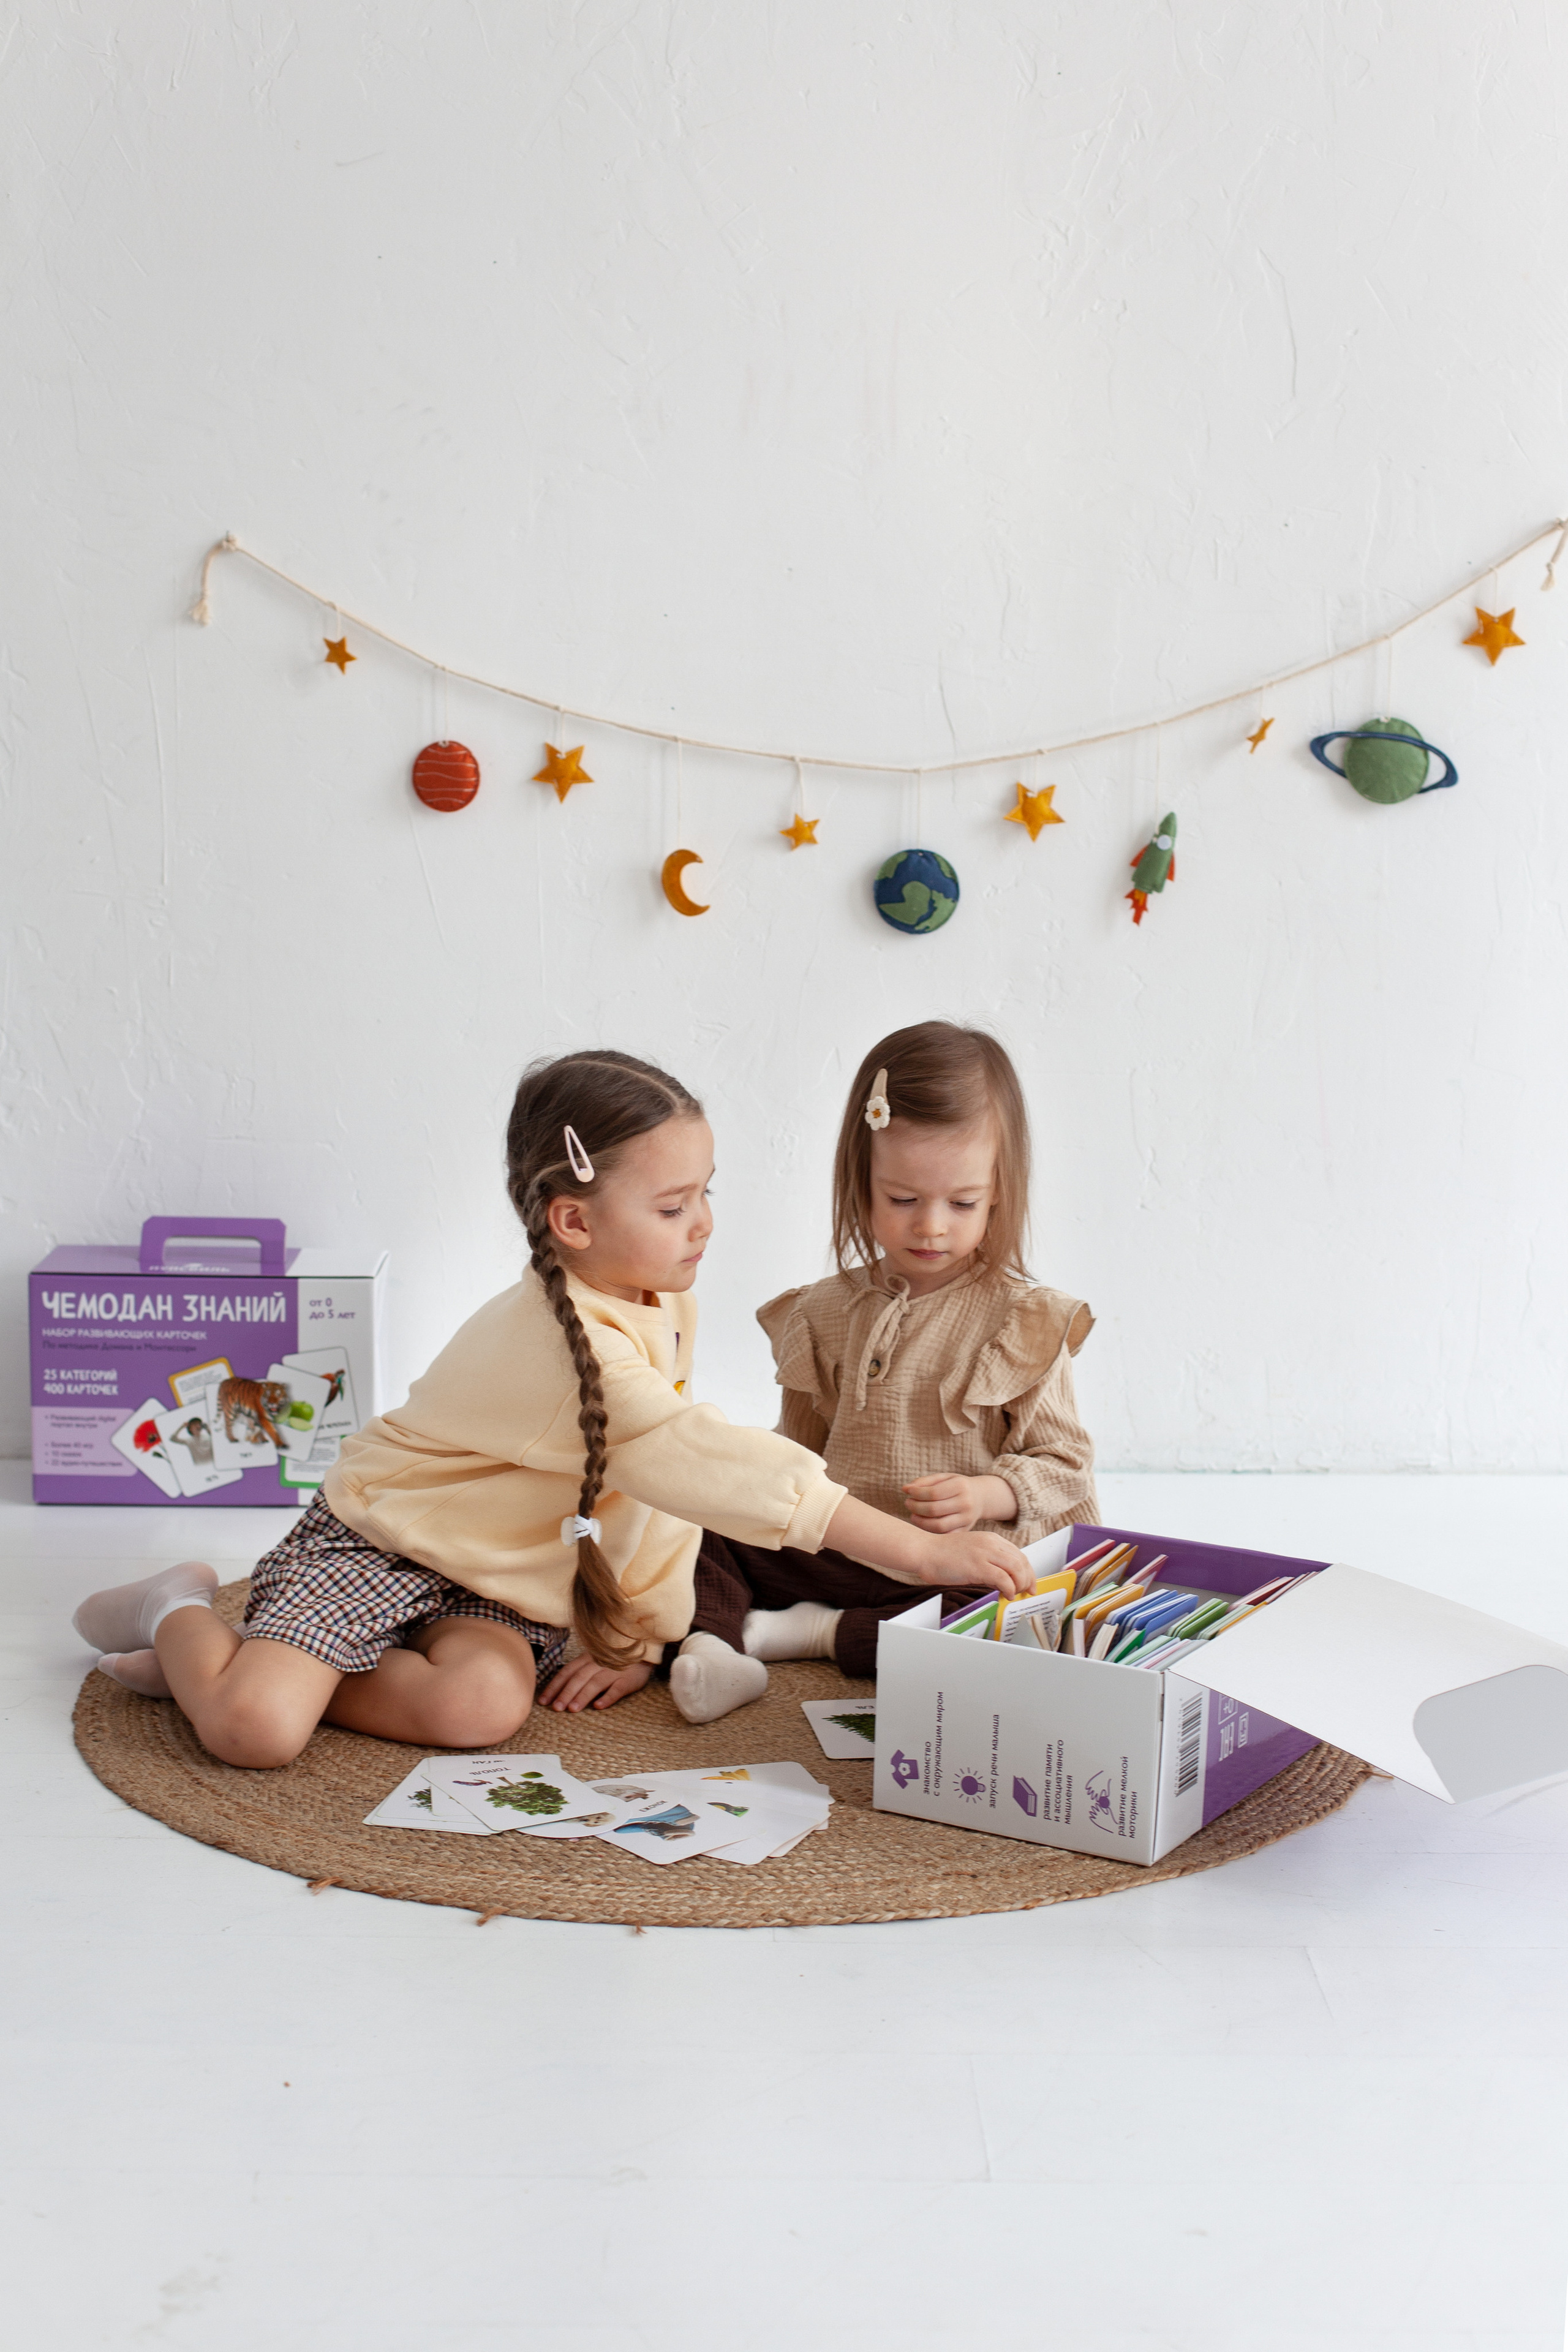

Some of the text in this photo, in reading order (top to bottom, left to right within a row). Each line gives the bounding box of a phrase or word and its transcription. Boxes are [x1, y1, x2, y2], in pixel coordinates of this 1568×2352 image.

[42, 1291, 287, 1322] ЧЕМОДАН ЗНАНИЙ
[309, 1311, 325, 1320] до
[328, 1309, 334, 1319] 5
[42, 1328, 208, 1340] НАБОР РАЗВИВАЮЩИХ КАРТОЧЕК
[43, 1368, 118, 1381] 25 КАТЕГОРИЙ
[43, 1383, 118, 1395] 400 КАРТОЧЕК
[937, 1691, 945, 1722] миром
[923, 1741, 932, 1795] знакомство
[934, 1725, 943, 1789] окружающим
[991, 1753, 1000, 1776] речи
[1054, 1740, 1064, 1814] ассоциативного
[989, 1778, 999, 1809] запуск
[1043, 1779, 1052, 1820] развитие
[1065, 1775, 1073, 1825] мышления
[1118, 1756, 1129, 1836] развитие мелкой
[1129, 1791, 1139, 1838] моторики
